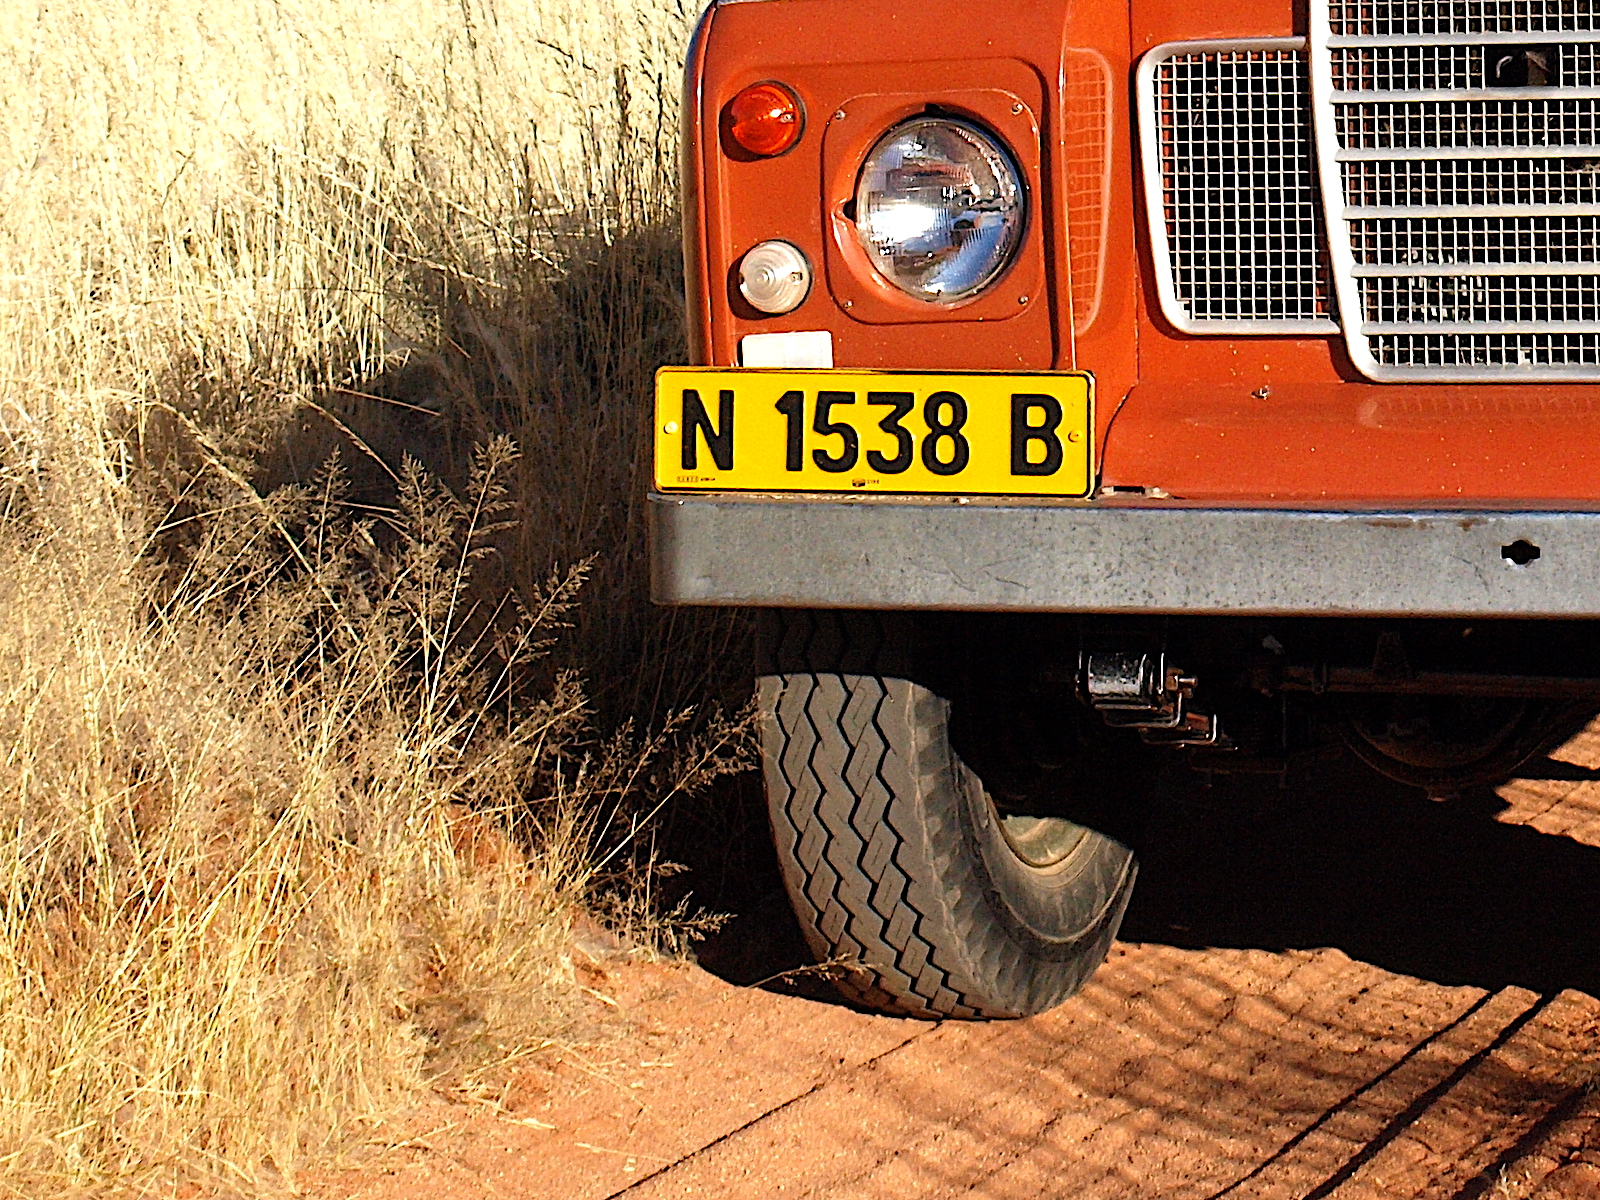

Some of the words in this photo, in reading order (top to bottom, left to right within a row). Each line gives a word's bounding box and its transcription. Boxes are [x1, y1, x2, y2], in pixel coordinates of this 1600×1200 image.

[681, 389, 735, 471] N
[774, 390, 970, 476] 1538
[1010, 393, 1064, 477] B
